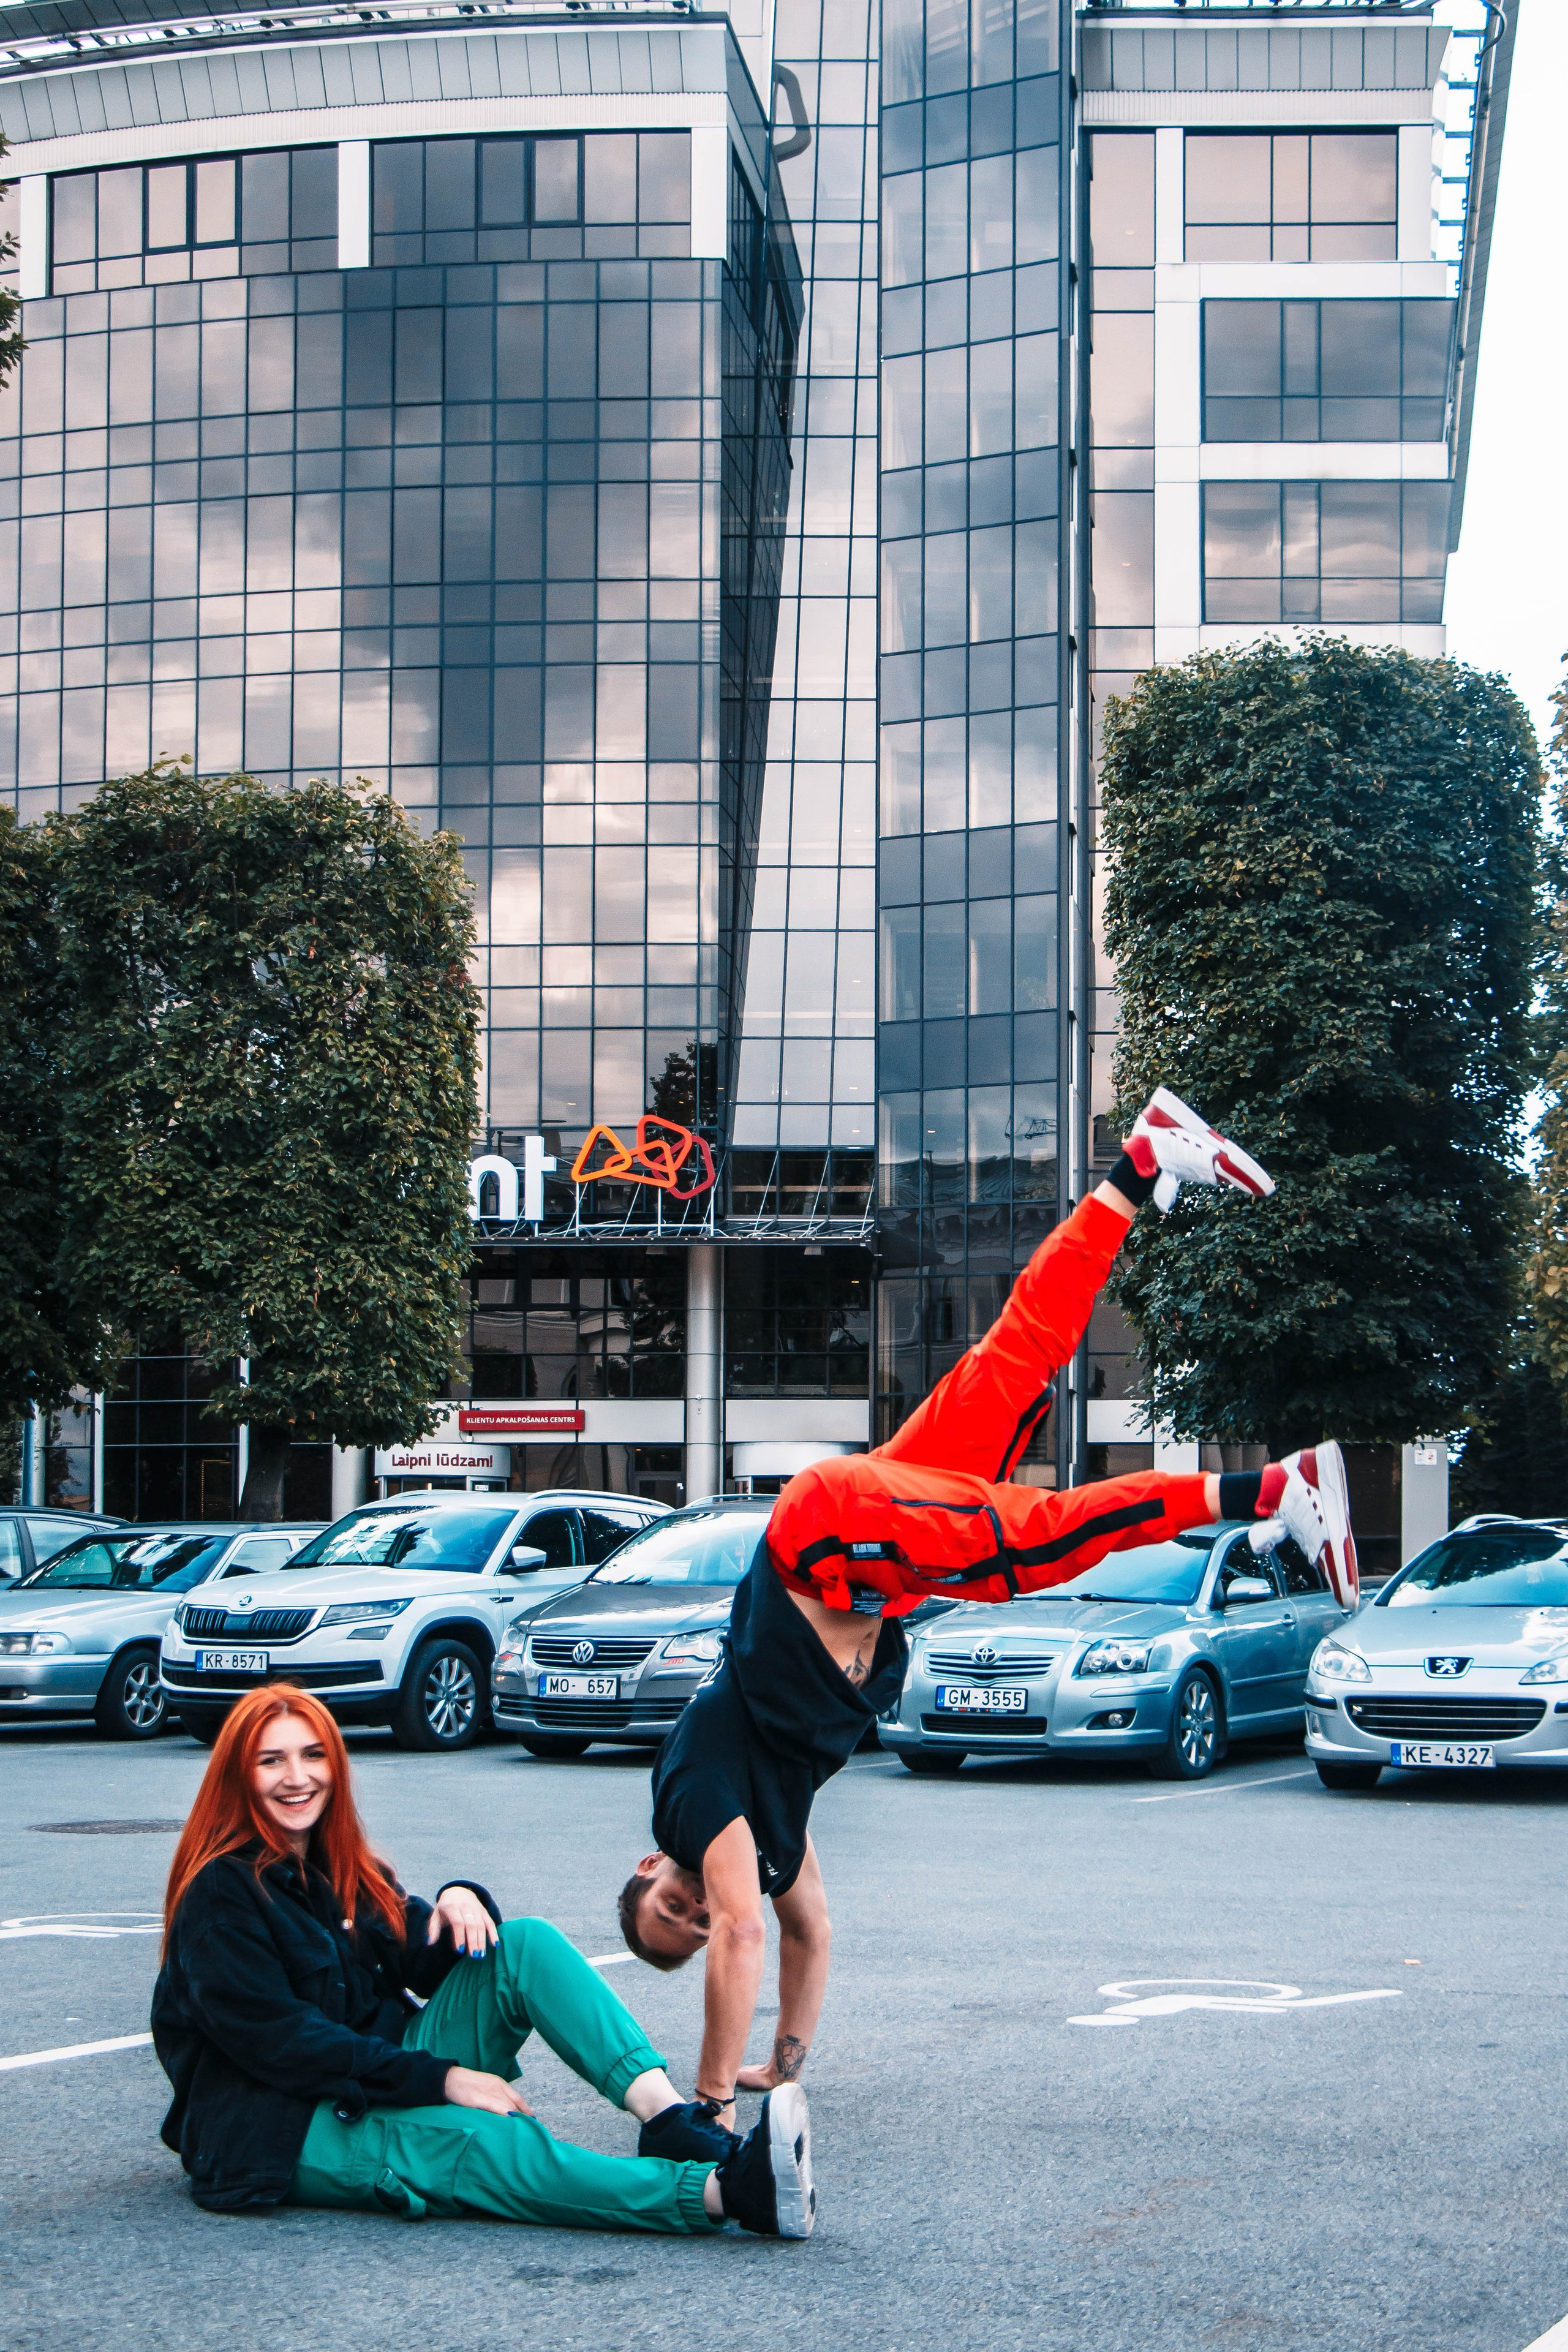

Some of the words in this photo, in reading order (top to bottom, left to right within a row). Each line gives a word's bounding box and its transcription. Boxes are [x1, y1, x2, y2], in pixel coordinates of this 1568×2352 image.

[496, 1415, 549, 1423] APKALPOŠANAS
[391, 1453, 431, 1469] Laipni
[436, 1453, 493, 1468] lūdzam!
[205, 1654, 263, 1669] KR-8571
[949, 1689, 1022, 1707] GM-3555
[1405, 1746, 1490, 1765] KE-4327
